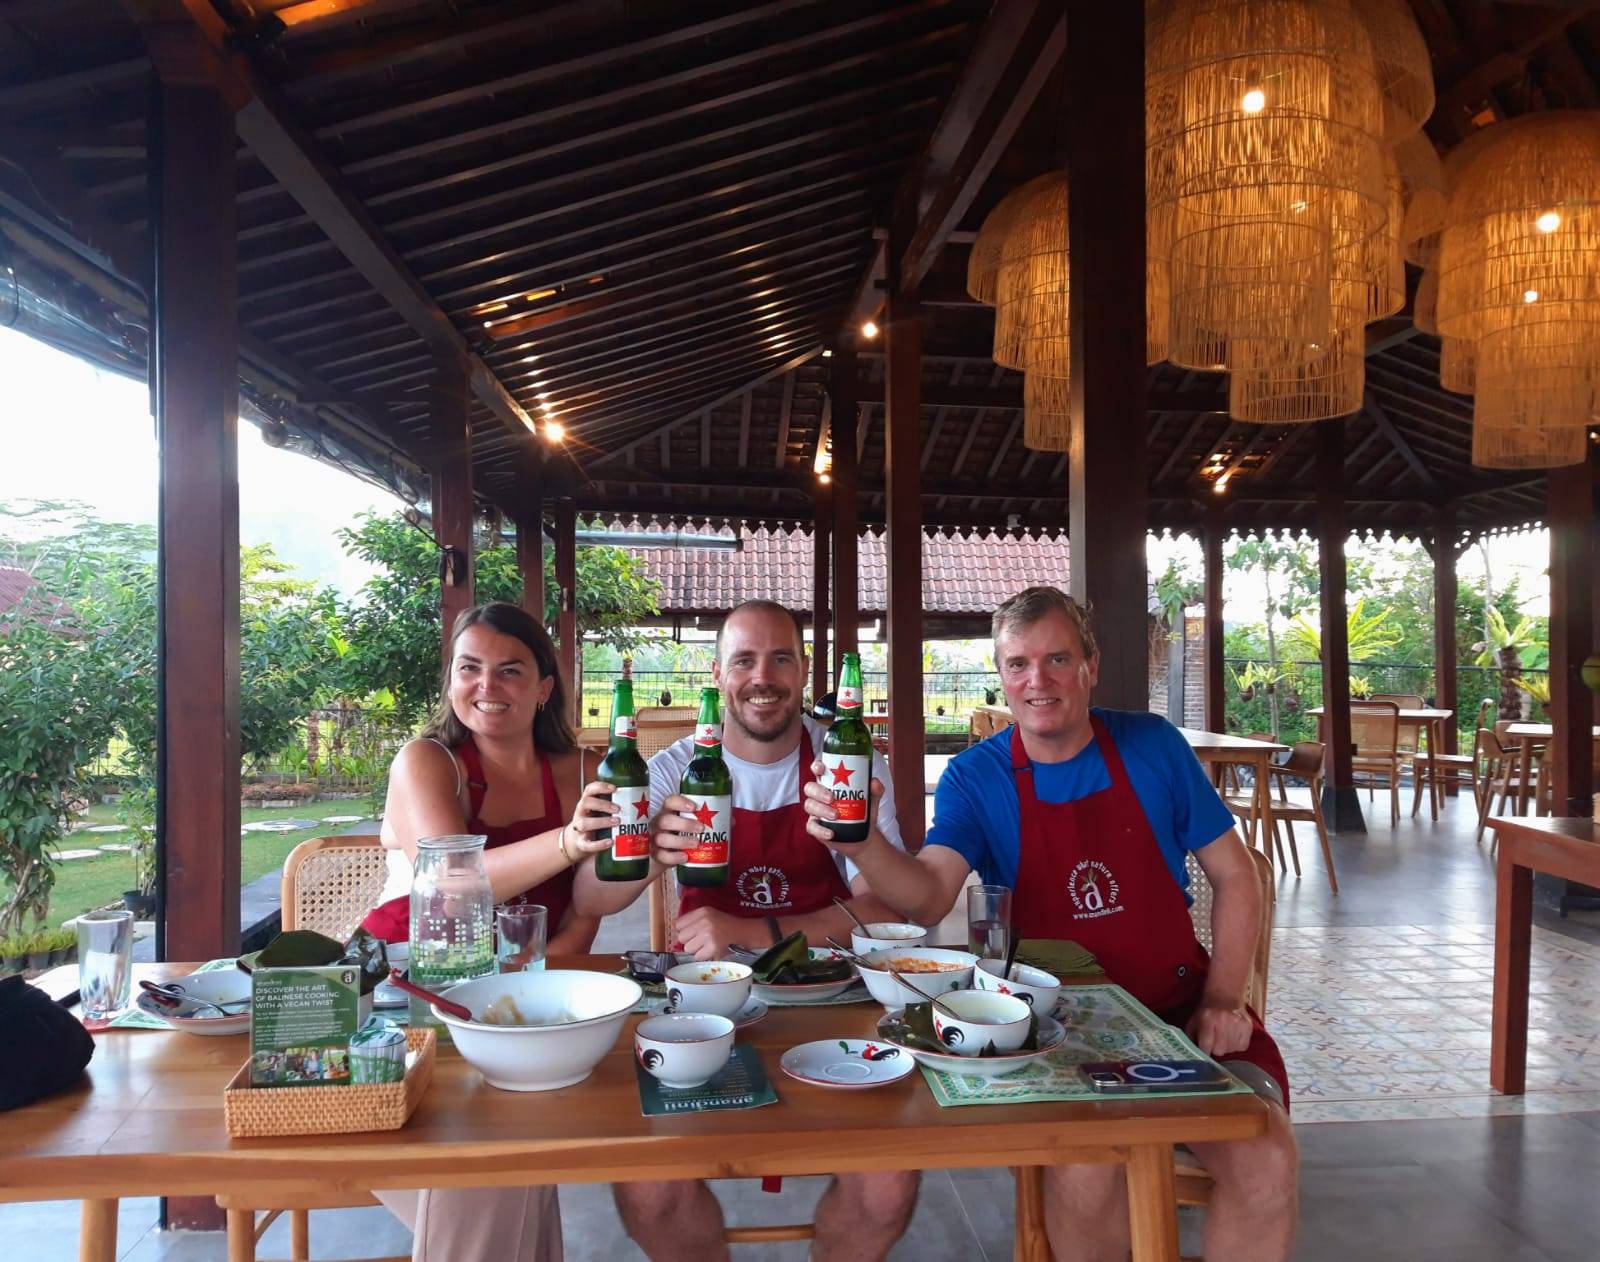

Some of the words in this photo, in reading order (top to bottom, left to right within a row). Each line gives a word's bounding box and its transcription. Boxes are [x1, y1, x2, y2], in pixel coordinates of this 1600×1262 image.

[619, 823, 649, 835] BINTA
[1090, 861, 1112, 879] nature
[1108, 880, 1119, 904] offers
[256, 986, 293, 994] DISCOVER
[267, 993, 304, 1001] BALINESE
[304, 991, 340, 999] COOKING
[283, 1000, 310, 1008] VEGAN
